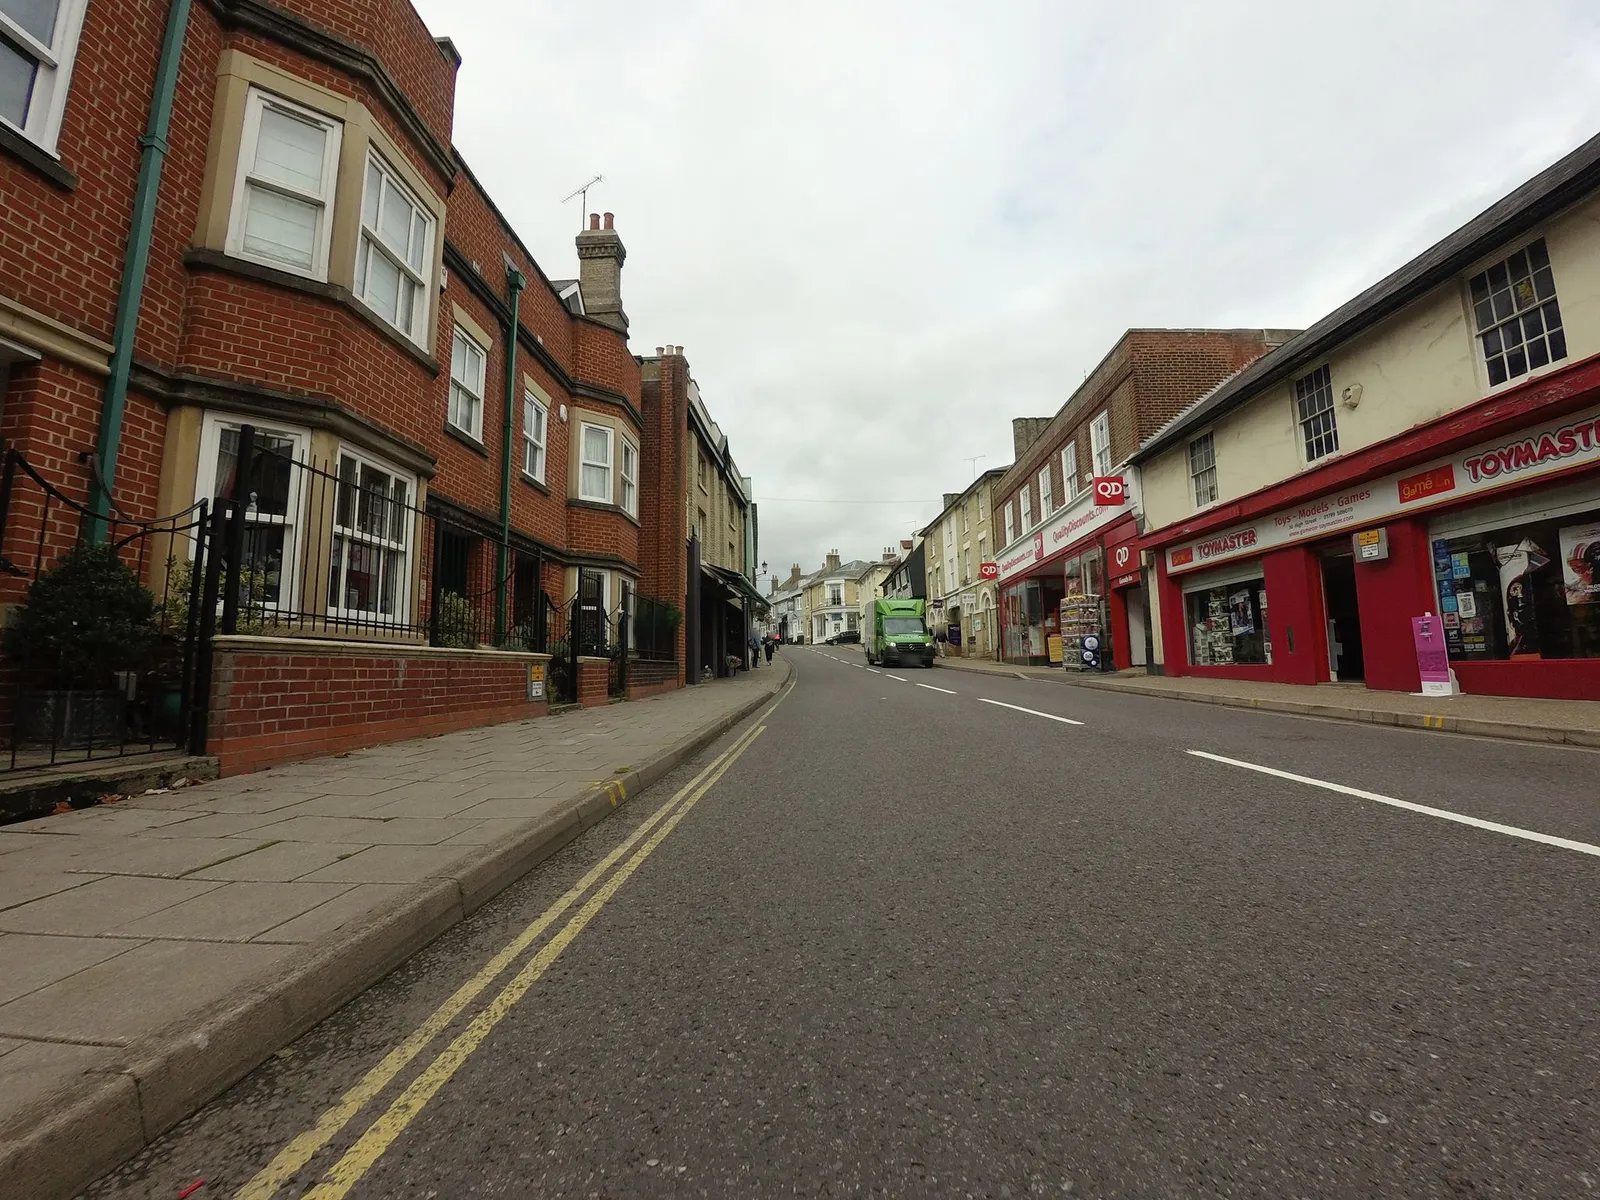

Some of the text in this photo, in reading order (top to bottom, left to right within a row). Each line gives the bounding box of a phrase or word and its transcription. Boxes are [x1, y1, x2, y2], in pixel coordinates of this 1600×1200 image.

[1097, 482, 1122, 498] QD
[1274, 515, 1291, 527] Toys
[1298, 502, 1329, 519] Models
[1337, 489, 1371, 507] Games
[1197, 528, 1257, 559] TOYMASTER
[1116, 547, 1129, 567] QD
[981, 566, 997, 576] QD
